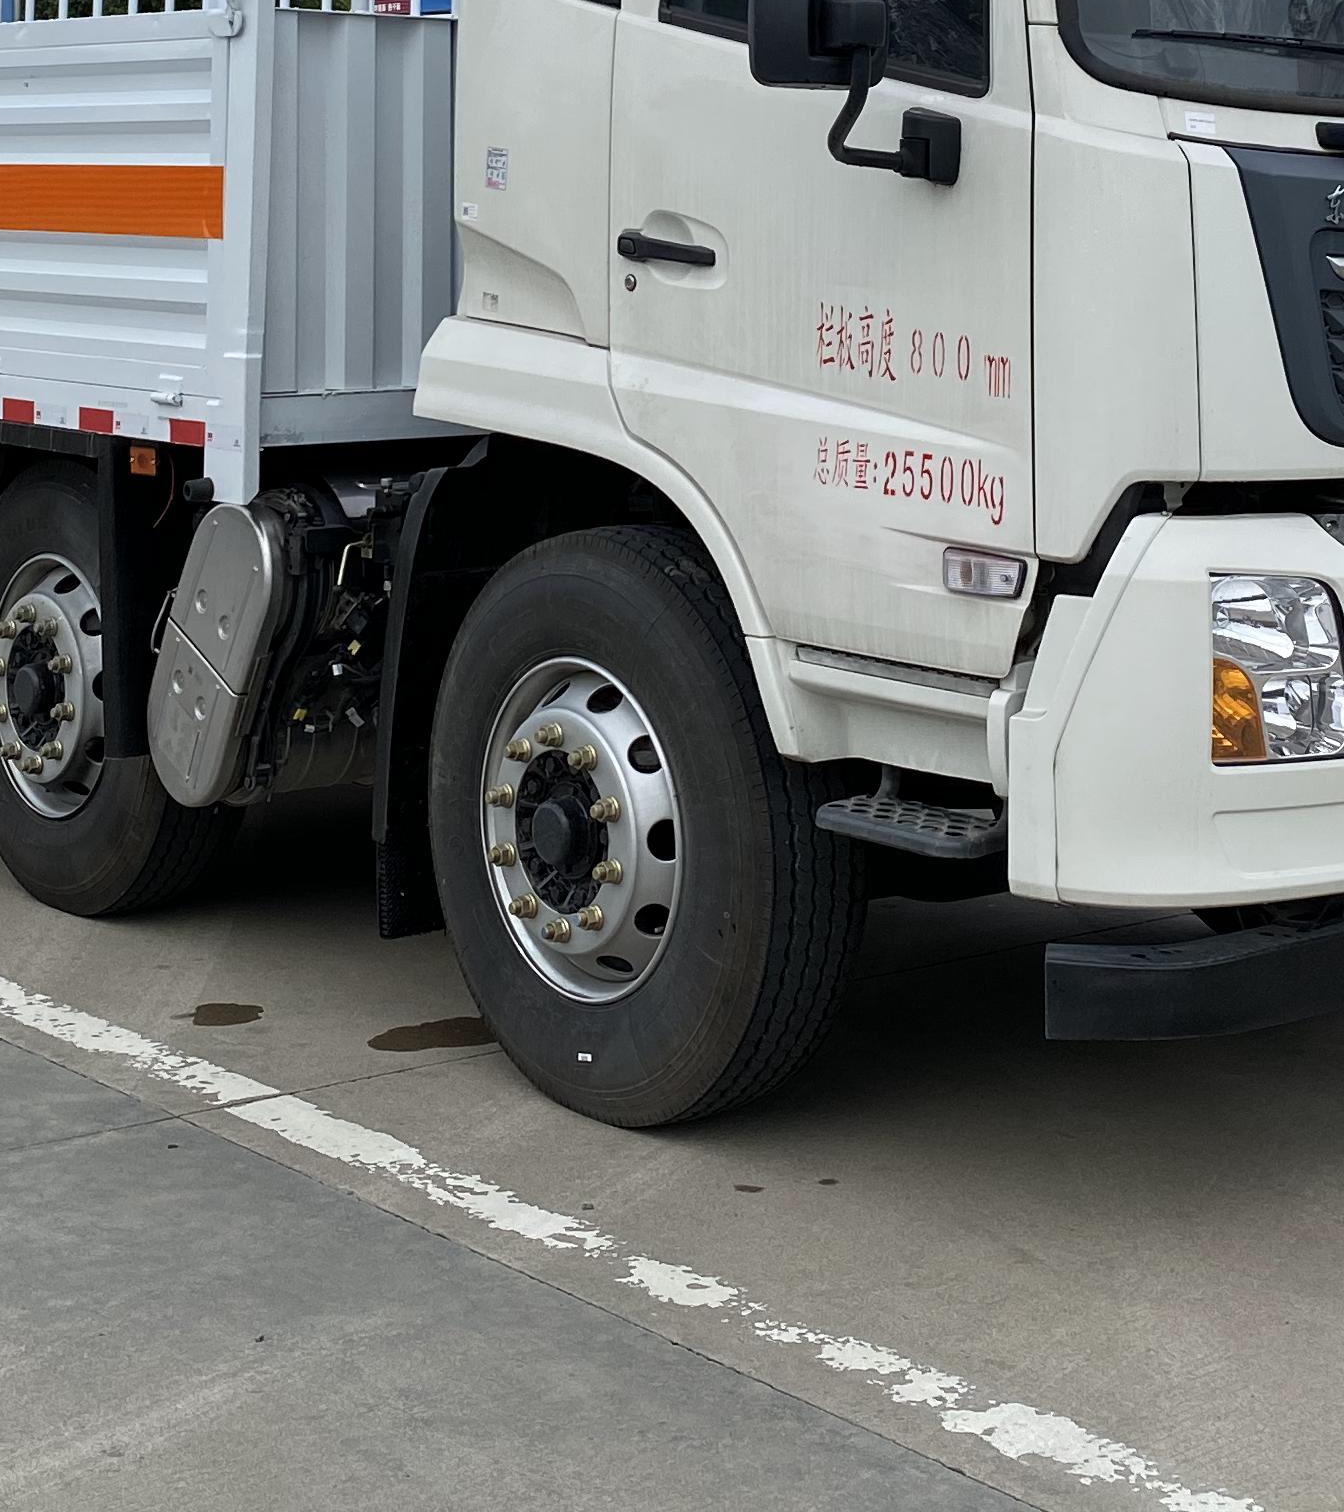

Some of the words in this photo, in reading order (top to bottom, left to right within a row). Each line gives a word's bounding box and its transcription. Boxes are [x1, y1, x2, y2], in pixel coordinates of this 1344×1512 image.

[816, 301, 896, 382] 栏板高度
[910, 328, 971, 381] 800
